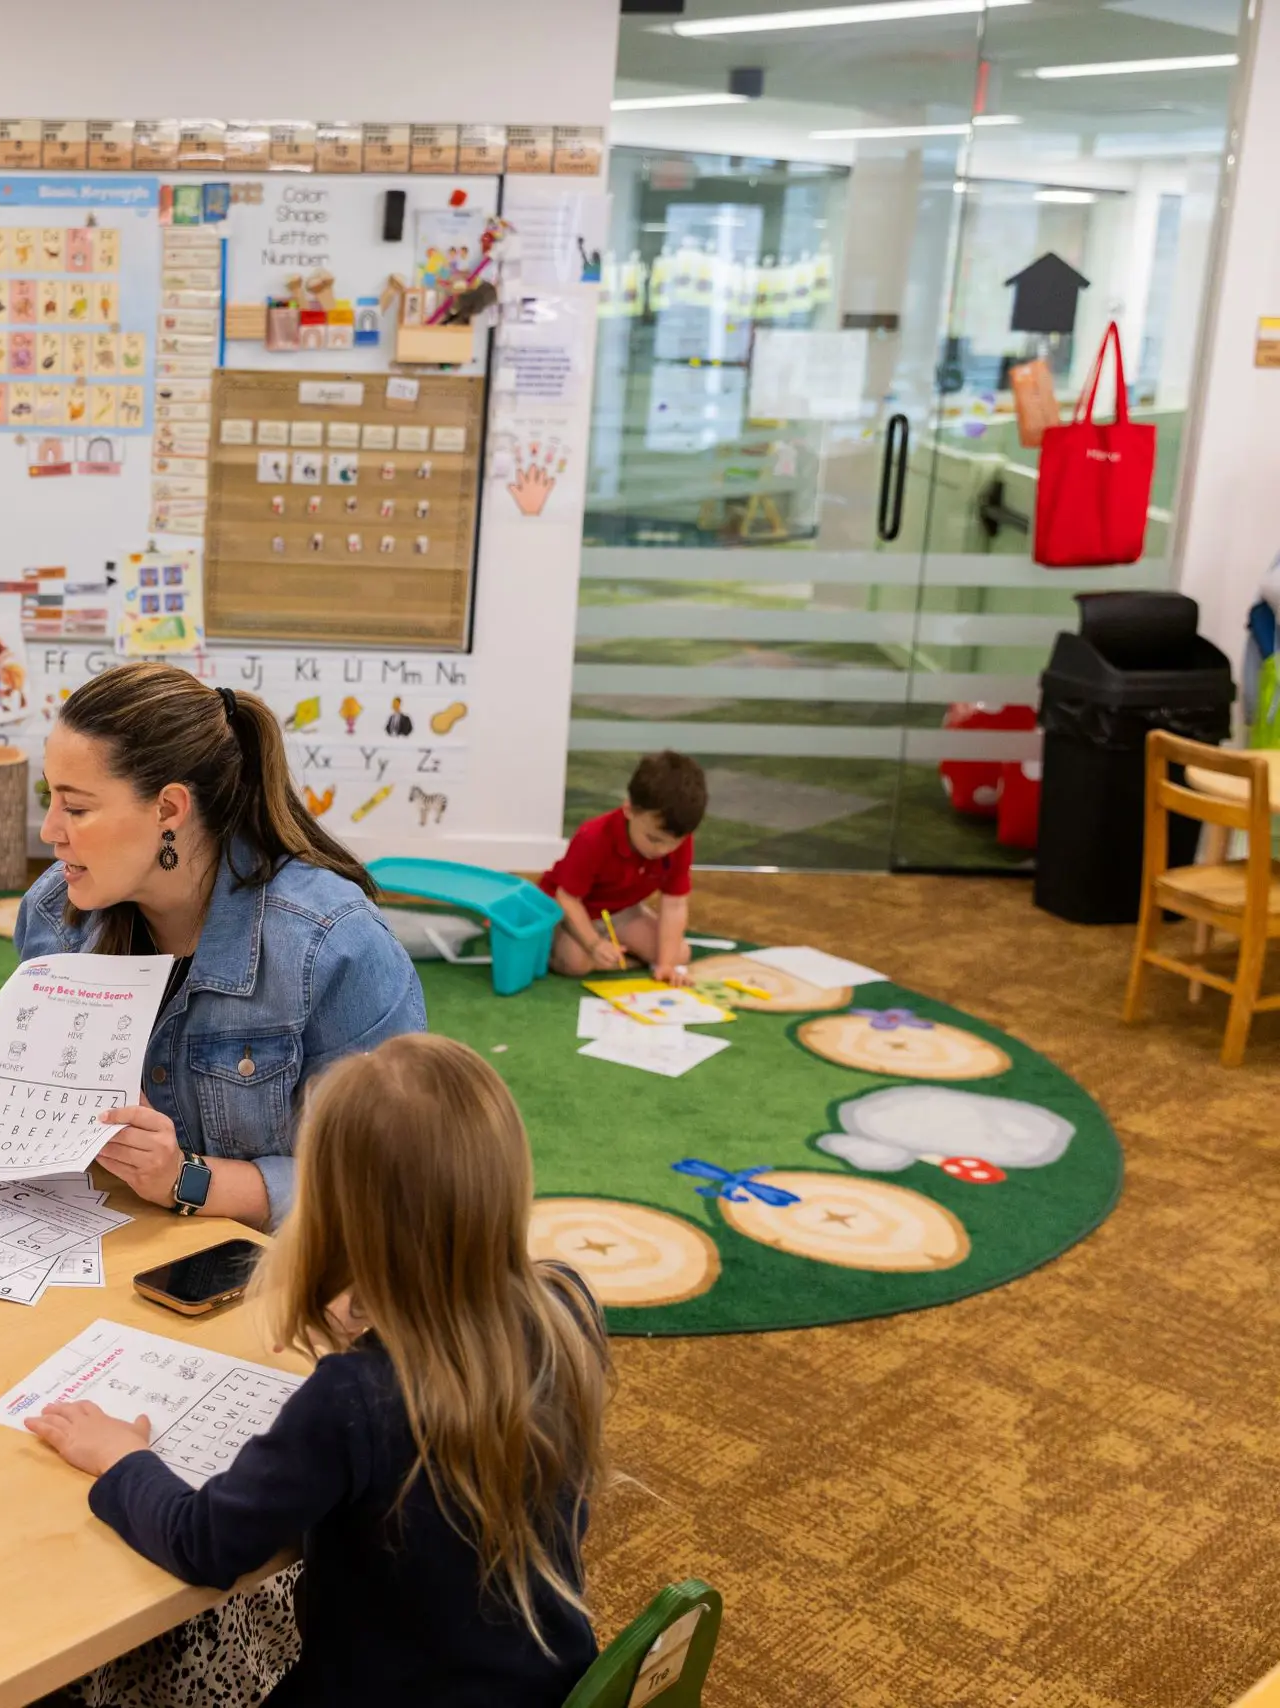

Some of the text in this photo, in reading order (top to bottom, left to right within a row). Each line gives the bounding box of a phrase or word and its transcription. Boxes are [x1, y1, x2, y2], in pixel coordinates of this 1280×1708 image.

[283, 187, 328, 203] Color
[276, 205, 327, 225] Shape
[268, 228, 328, 245] Letter
[262, 250, 330, 266] Number
[44, 651, 67, 673] Ff
[241, 656, 263, 690] Jj
[295, 660, 320, 681] Kk
[345, 661, 362, 682] Ll
[382, 661, 422, 683] Mm
[437, 662, 466, 685] Nn
[304, 745, 441, 780] Xx Yy Zz
[33, 984, 133, 1000] Busy Bee Word Search
[0, 1063, 24, 1072] HONEY
[52, 1071, 78, 1080] FLOWER
[13, 1192, 30, 1200] C
[17, 1239, 40, 1250] c_n
[65, 1383, 80, 1394] Bee
[80, 1367, 101, 1382] Word
[100, 1349, 124, 1368] Search
